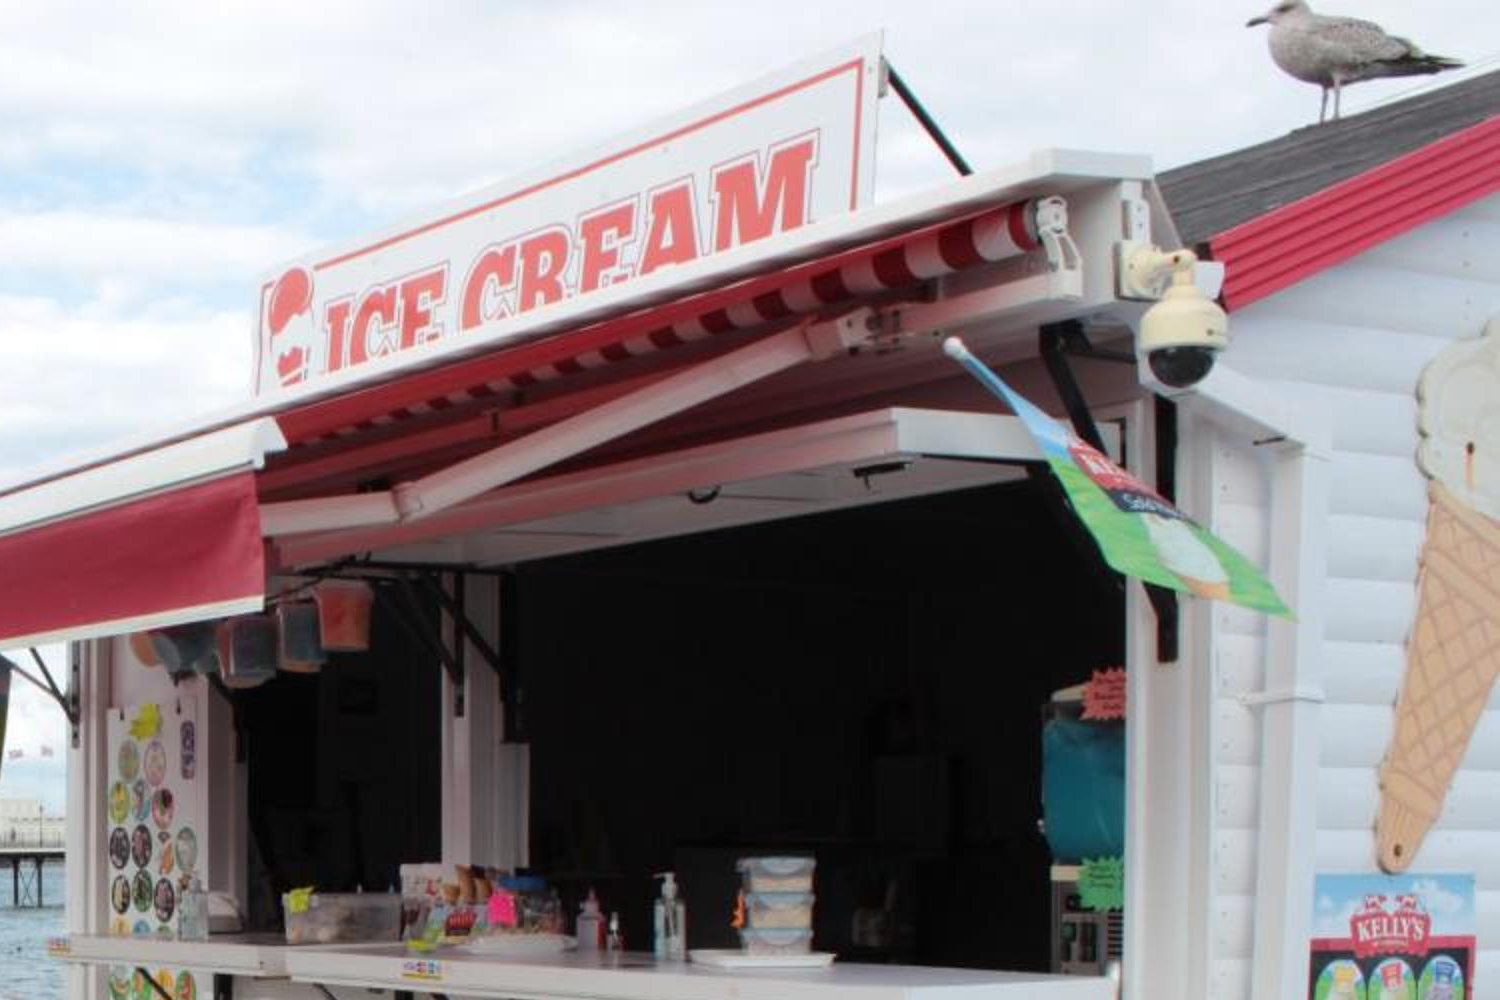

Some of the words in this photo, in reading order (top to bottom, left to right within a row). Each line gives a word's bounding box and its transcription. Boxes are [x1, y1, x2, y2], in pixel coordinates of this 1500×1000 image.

[323, 266, 448, 374] ICE
[460, 129, 820, 331] CREAM
[1357, 915, 1425, 942] KELLY'S
